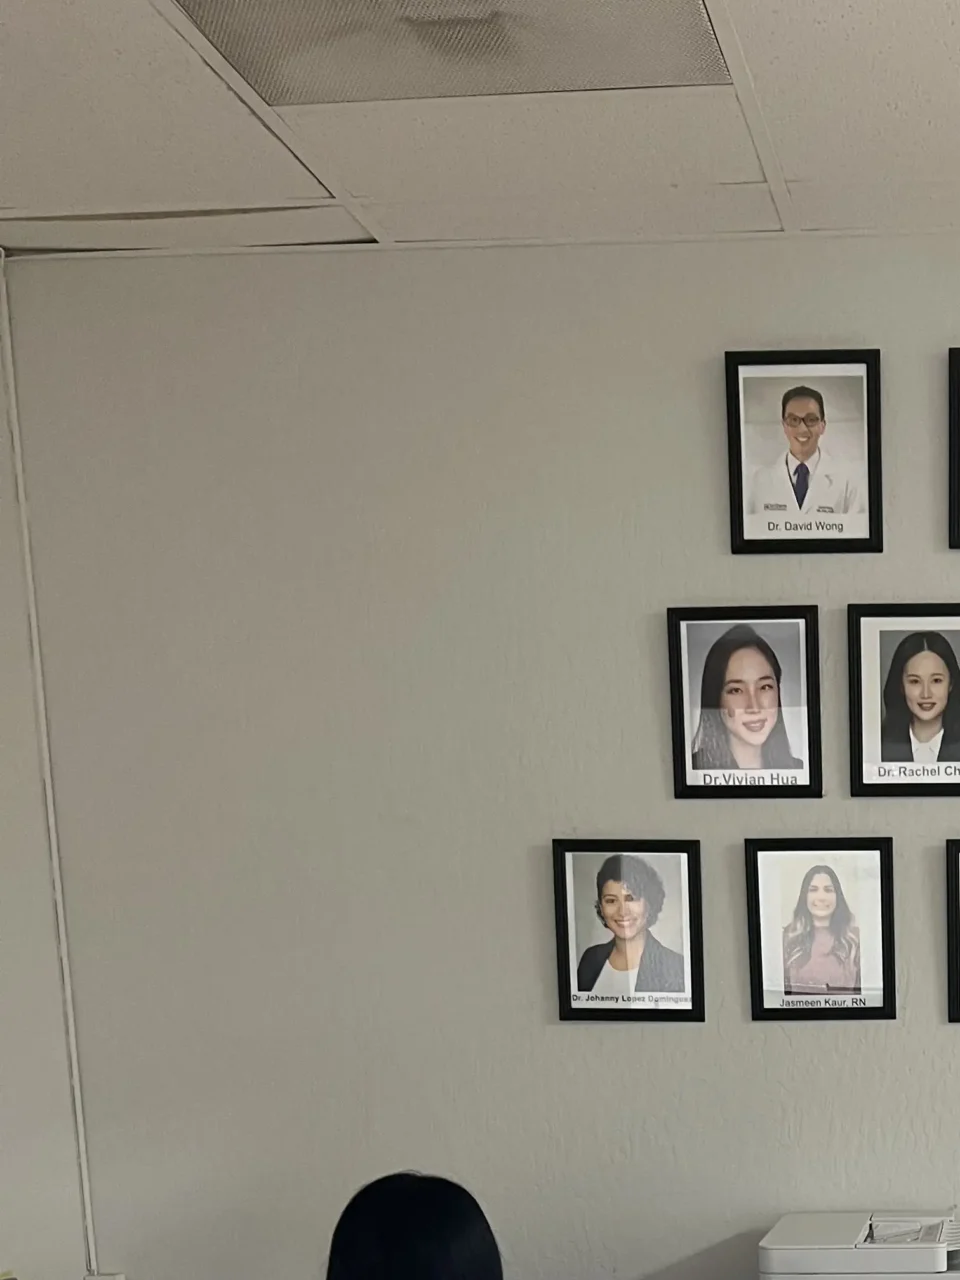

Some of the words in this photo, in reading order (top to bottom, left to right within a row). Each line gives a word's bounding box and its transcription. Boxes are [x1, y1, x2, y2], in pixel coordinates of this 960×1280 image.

[767, 521, 781, 531] Dr.
[784, 521, 813, 531] David
[815, 521, 844, 533] Wong
[878, 766, 895, 777] Dr.
[898, 765, 940, 777] Rachel
[770, 773, 798, 785] Hua
[572, 994, 583, 1002] Dr.
[621, 994, 646, 1003] Lopez
[780, 998, 821, 1007] Jasmeen
[824, 998, 848, 1008] Kaur,
[851, 998, 866, 1006] RN
